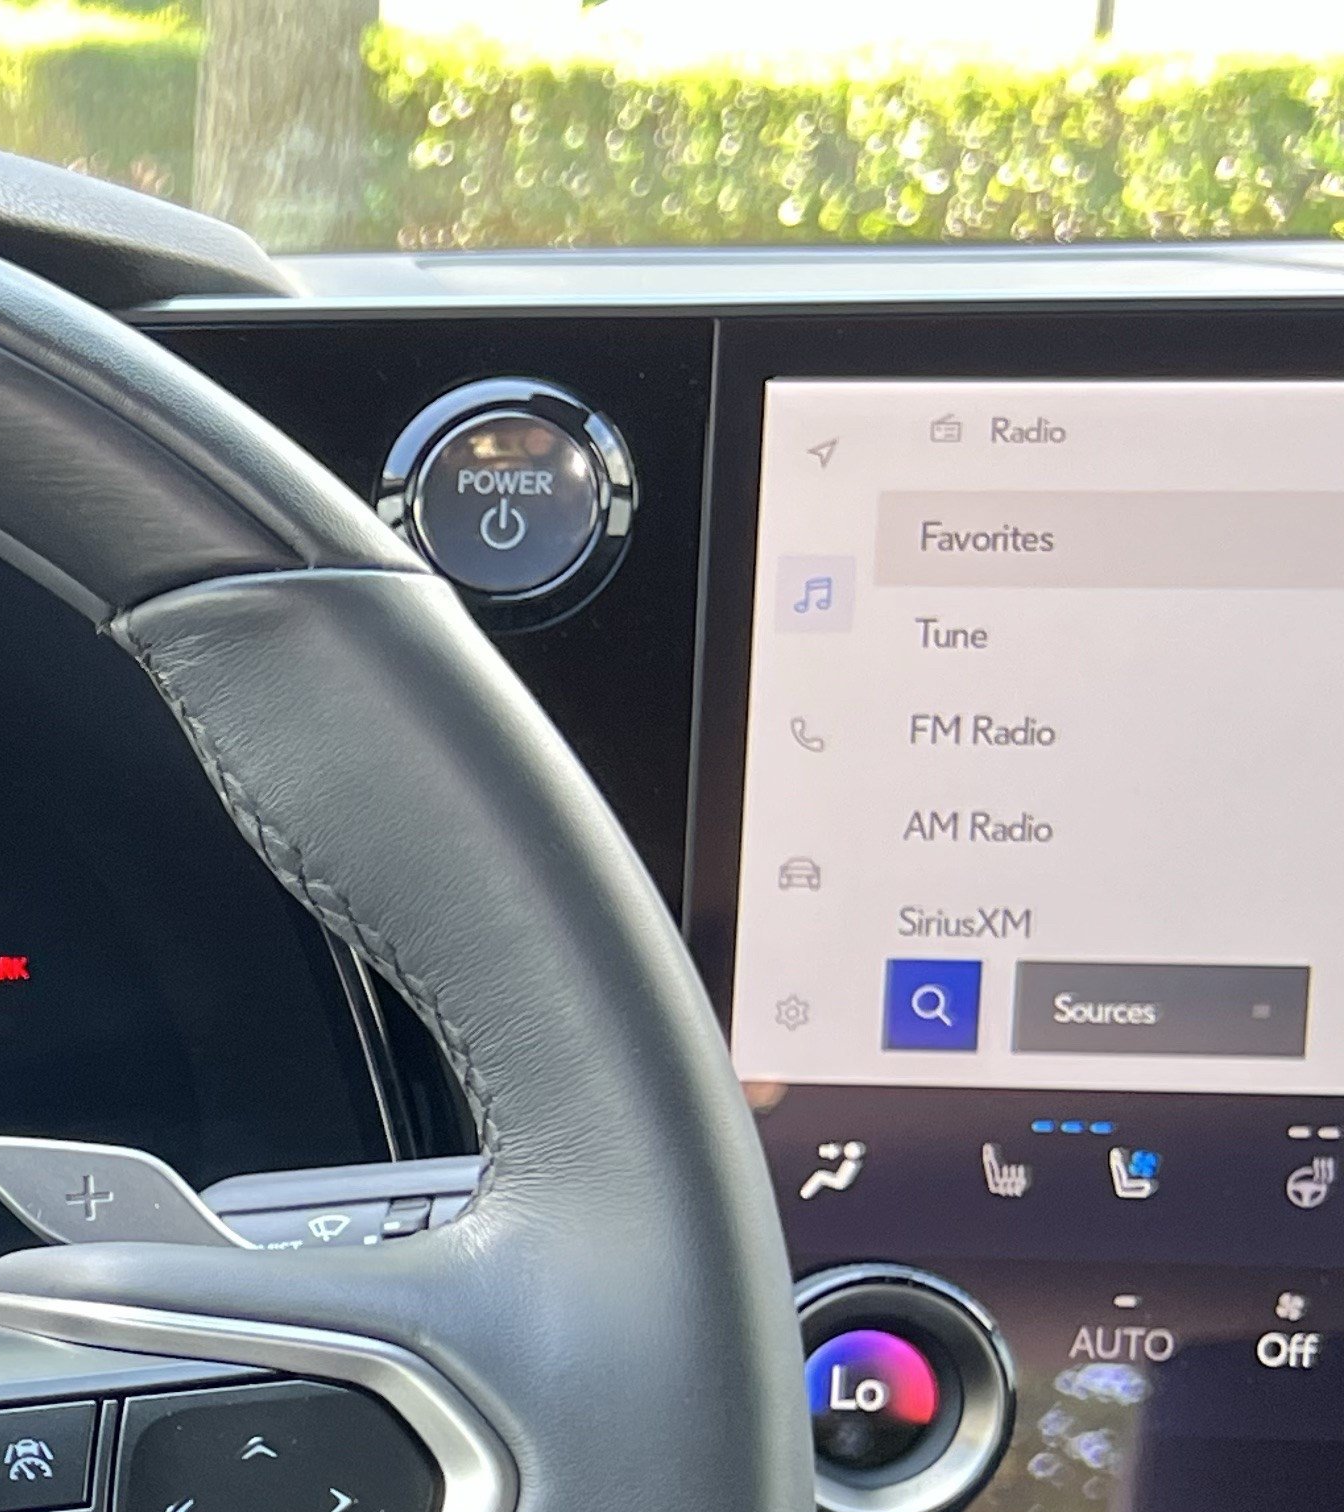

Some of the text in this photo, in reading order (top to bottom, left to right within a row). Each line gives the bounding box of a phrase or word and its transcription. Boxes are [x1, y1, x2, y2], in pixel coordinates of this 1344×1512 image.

[990, 417, 1067, 447] Radio
[458, 470, 553, 495] POWER
[920, 522, 1055, 555] Favorites
[915, 618, 989, 650] Tune
[909, 716, 1057, 748] FM Radio
[903, 811, 1054, 843] AM Radio
[897, 909, 1032, 940] SiriusXM
[1053, 997, 1157, 1028] Sources
[1069, 1327, 1176, 1363] AUTO
[1256, 1332, 1321, 1369] Off
[829, 1365, 888, 1413] Lo
